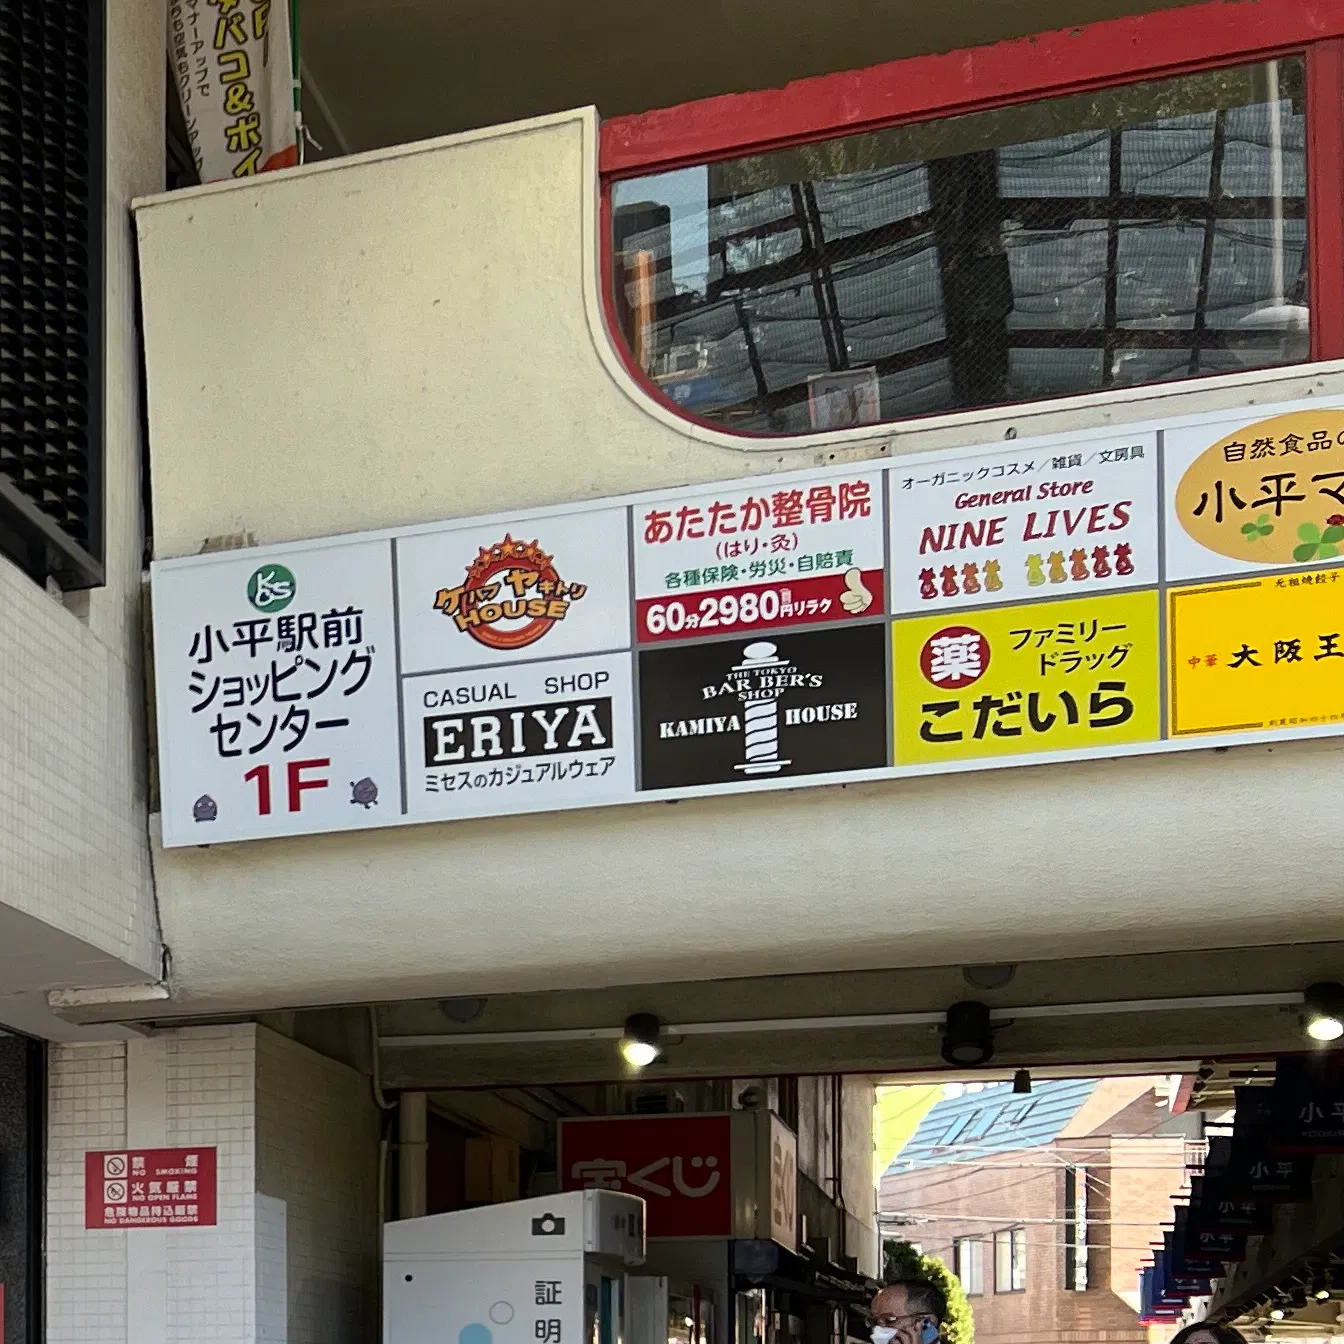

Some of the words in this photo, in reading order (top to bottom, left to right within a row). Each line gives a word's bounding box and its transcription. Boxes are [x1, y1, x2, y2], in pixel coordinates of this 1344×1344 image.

[644, 480, 872, 544] あたたか整骨院
[955, 485, 1032, 510] General
[1037, 479, 1094, 501] Store
[919, 516, 1008, 555] NINE
[1023, 501, 1132, 542] LIVES
[665, 549, 854, 588] 各種保険・労災・自賠責
[452, 597, 570, 632] HOUSE
[188, 606, 364, 662] 小平駅前
[1009, 620, 1127, 650] ファミリー
[1227, 633, 1344, 668] 大阪王
[726, 669, 750, 681] THE
[753, 666, 797, 677] TOKYO
[928, 636, 983, 682] 薬
[1038, 643, 1132, 677] ドラッグ
[188, 646, 375, 713] ショッピング
[423, 681, 518, 708] CASUAL
[544, 671, 611, 700] SHOP
[738, 687, 785, 702] SHOP
[659, 715, 741, 738] KAMIYA
[785, 702, 858, 726] HOUSE
[919, 680, 1135, 743] こだいら
[210, 703, 350, 758] センター
[432, 703, 608, 763] ERIYA
[244, 758, 331, 815] 1F
[424, 756, 617, 793] ミセスのカジュアルウェア
[1248, 1161, 1295, 1180] 小平
